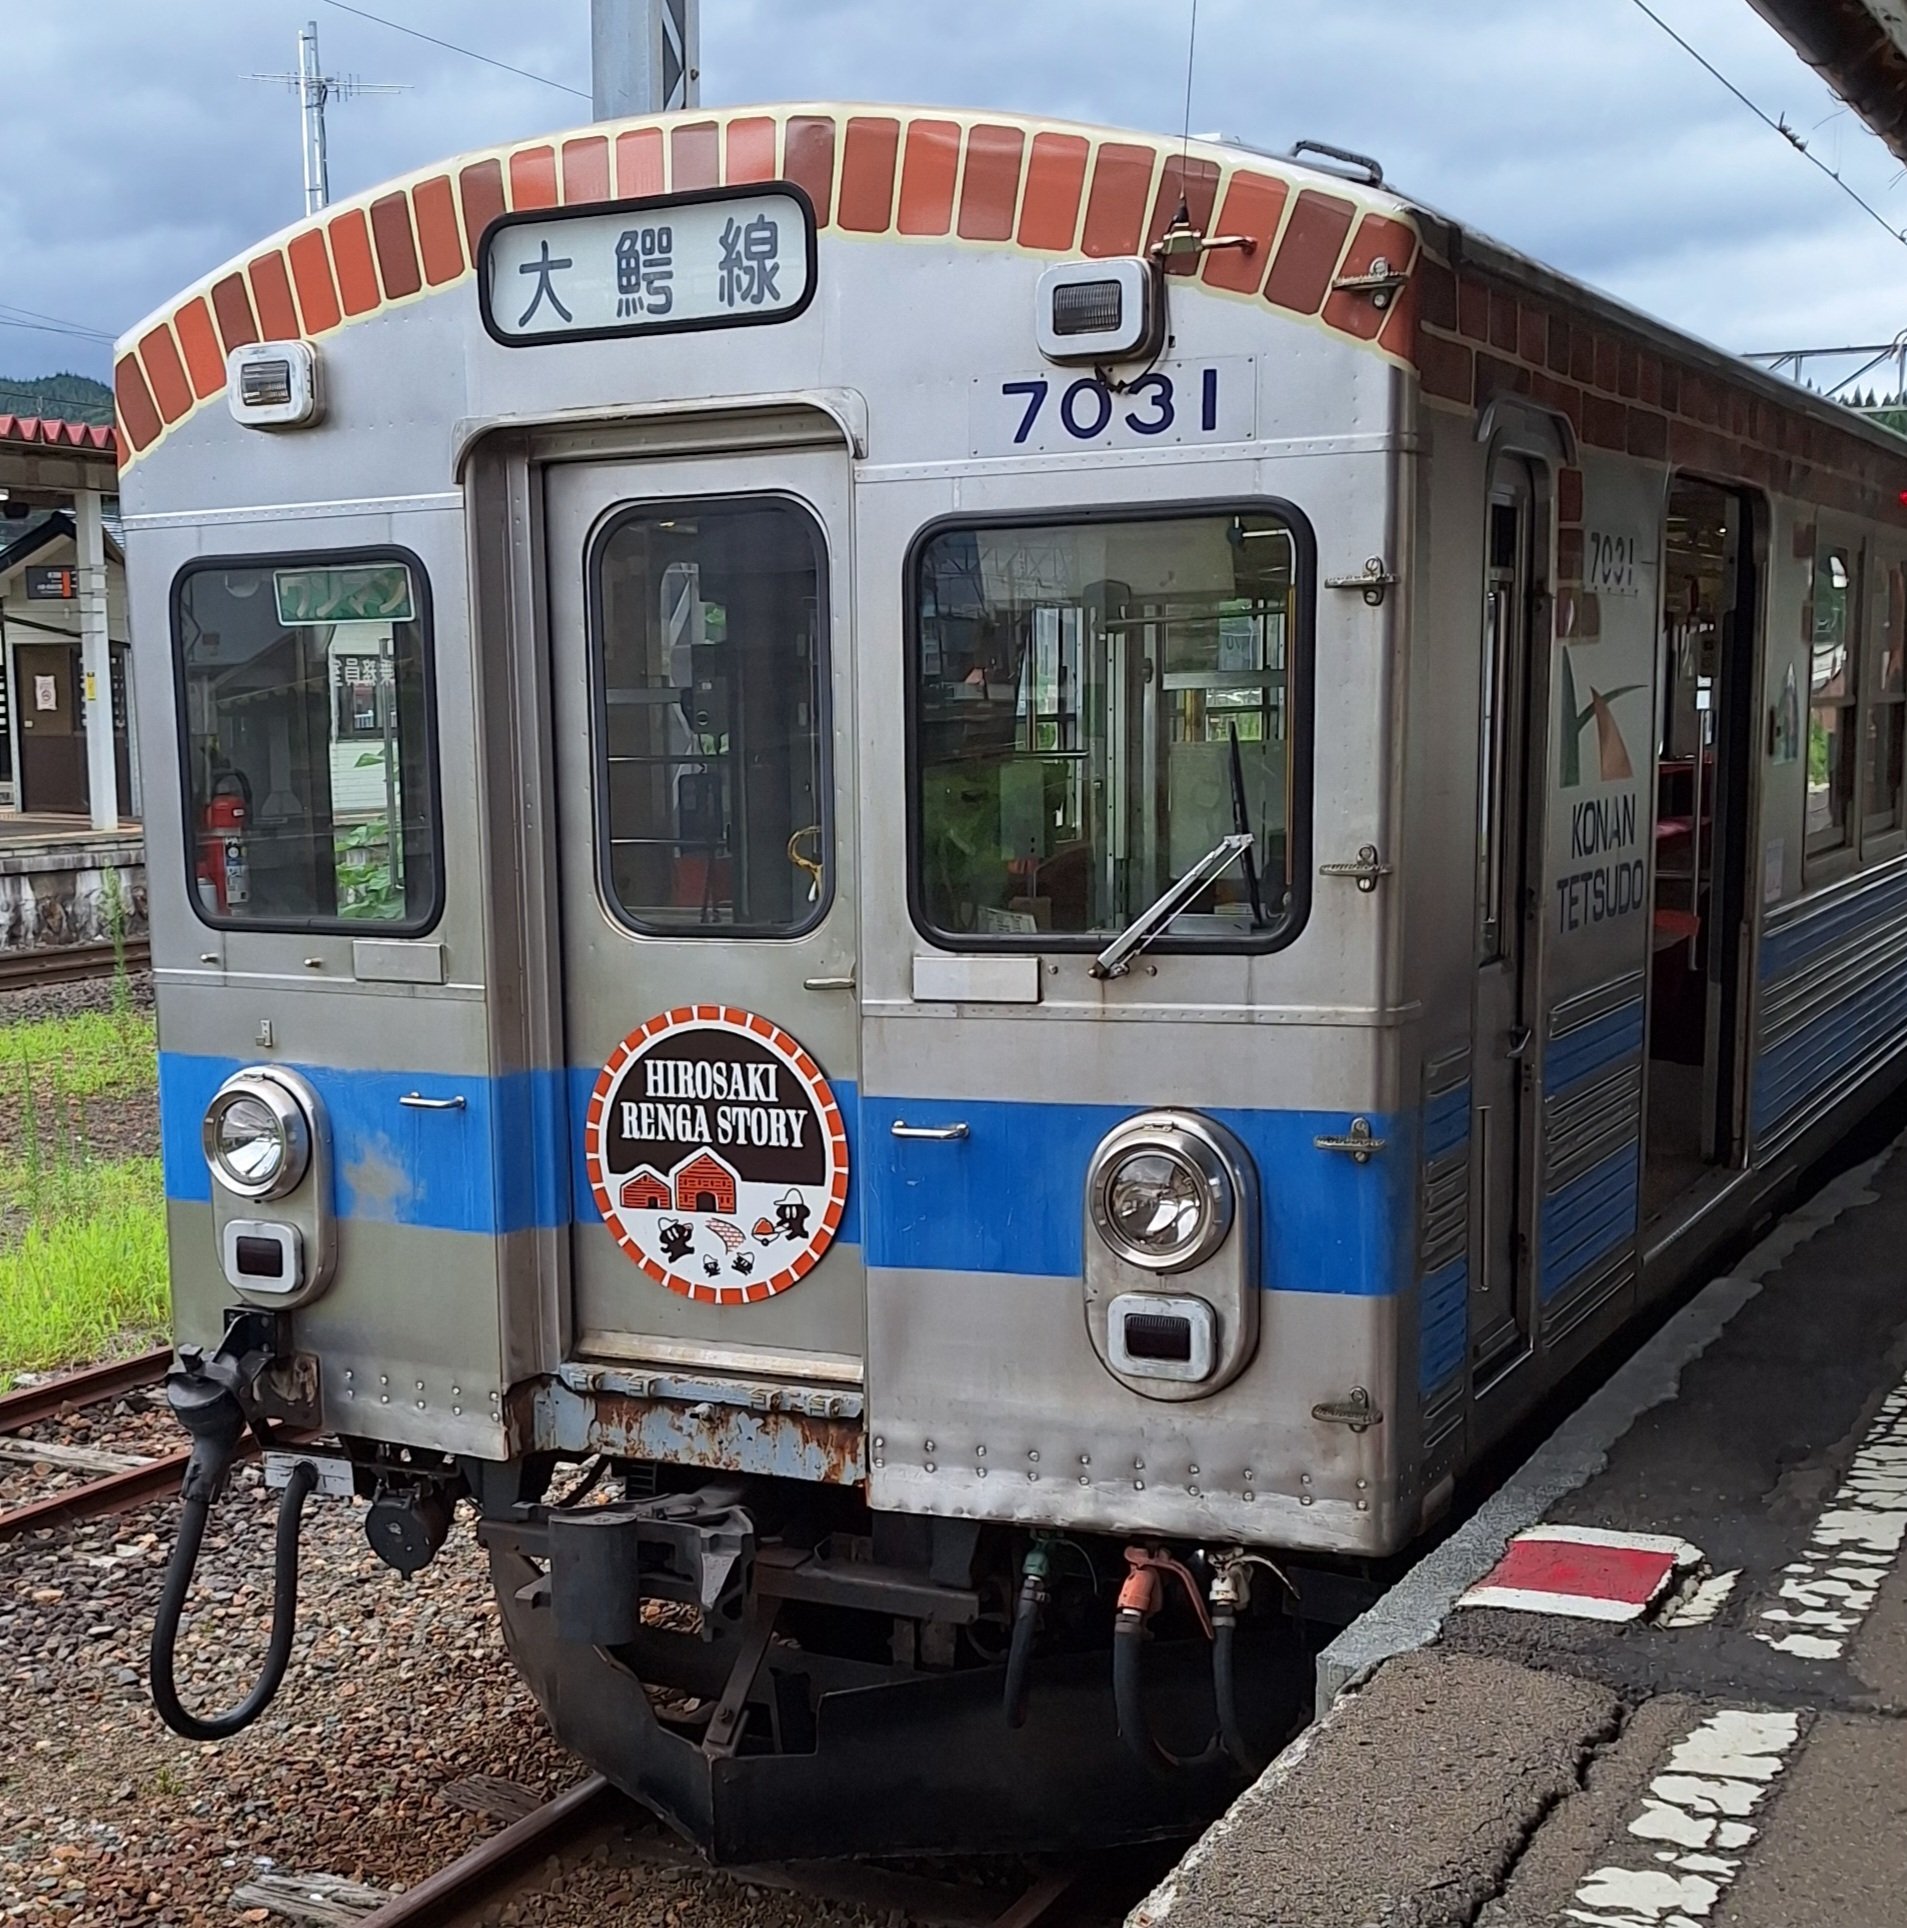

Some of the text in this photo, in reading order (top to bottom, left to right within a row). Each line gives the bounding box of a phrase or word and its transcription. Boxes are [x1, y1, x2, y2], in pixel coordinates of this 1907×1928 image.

[518, 213, 781, 328] 大鰐線
[1002, 368, 1217, 443] 7031
[1590, 531, 1634, 586] 7031
[1571, 793, 1636, 860] KONAN
[1556, 859, 1643, 934] TETSUDO
[644, 1059, 779, 1102] HIROSAKI
[620, 1101, 808, 1148] RENGA STORY
